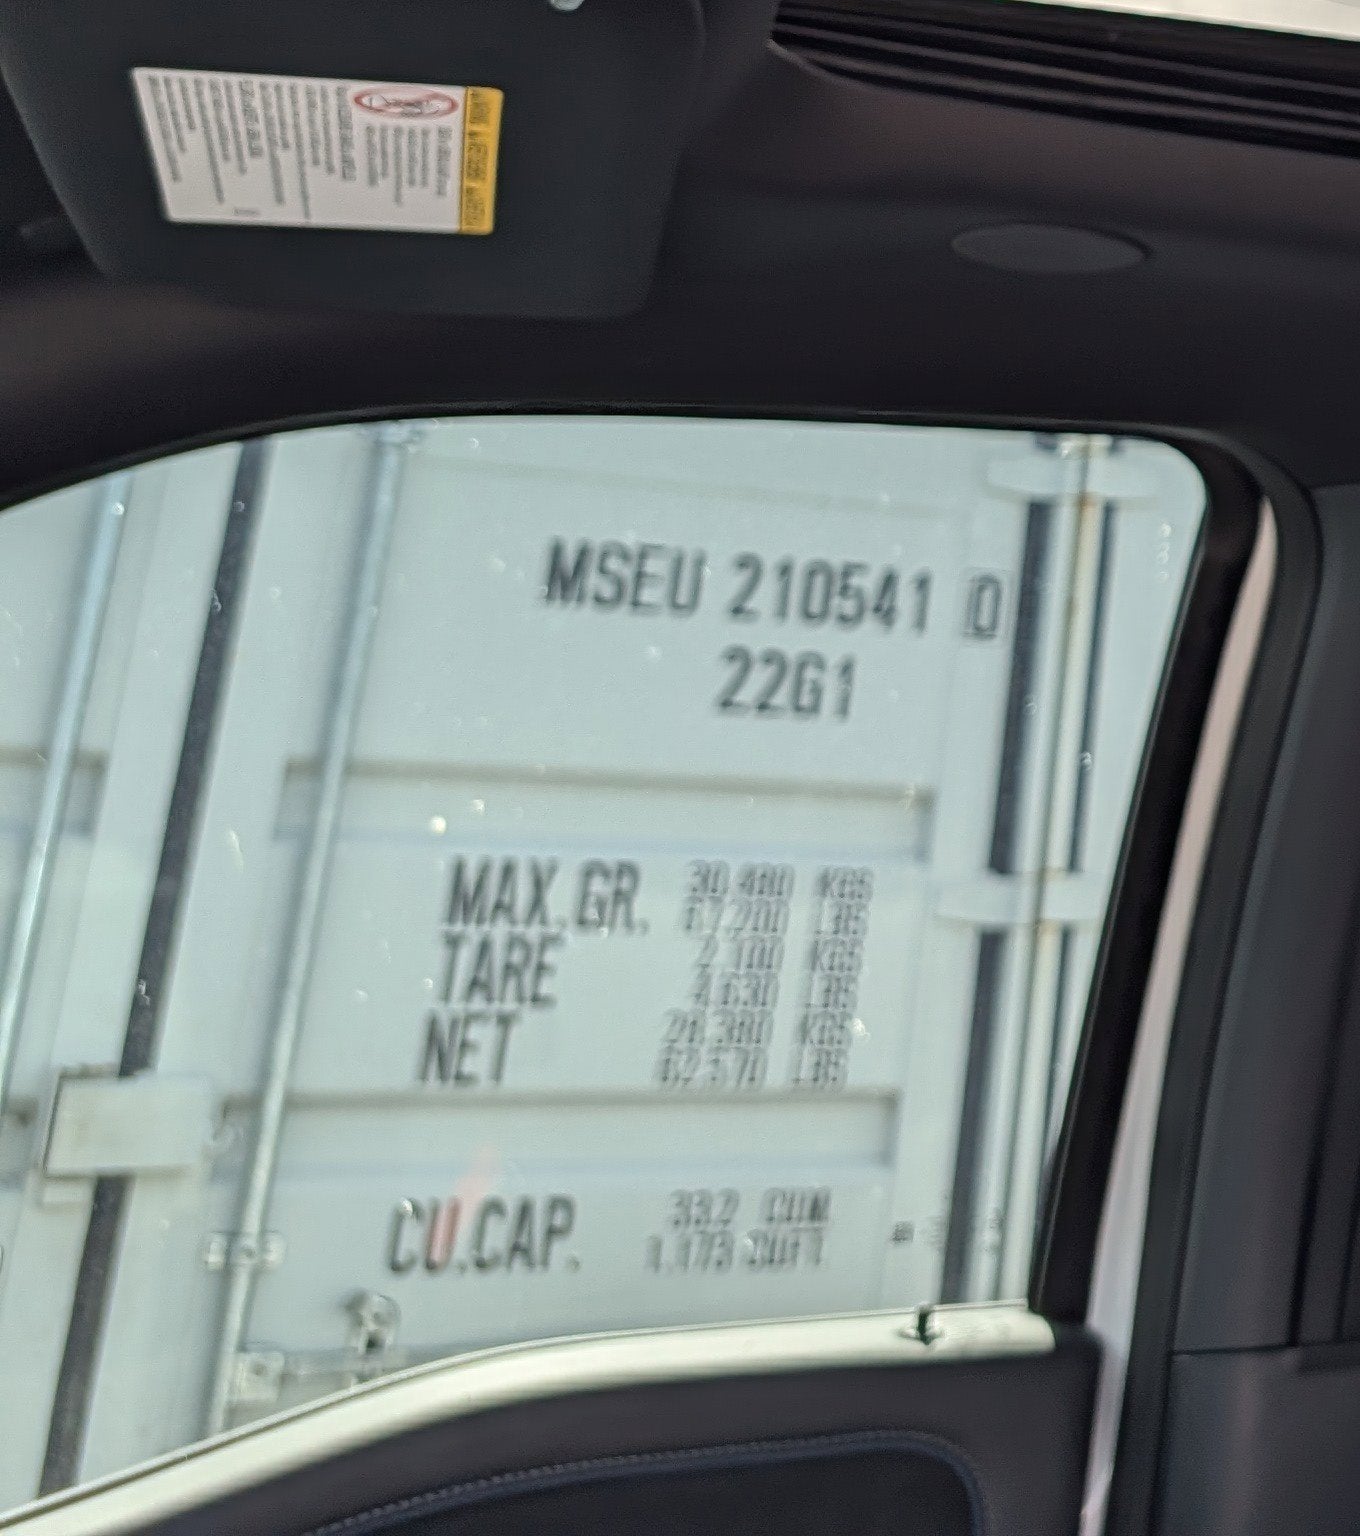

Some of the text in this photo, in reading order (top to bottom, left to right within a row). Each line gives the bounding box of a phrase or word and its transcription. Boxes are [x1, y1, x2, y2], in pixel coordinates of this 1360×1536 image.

[544, 536, 1003, 639] MSEU 210541 0
[717, 644, 858, 722] 22G1
[438, 930, 566, 1008] TARE
[416, 1008, 519, 1088] NET
